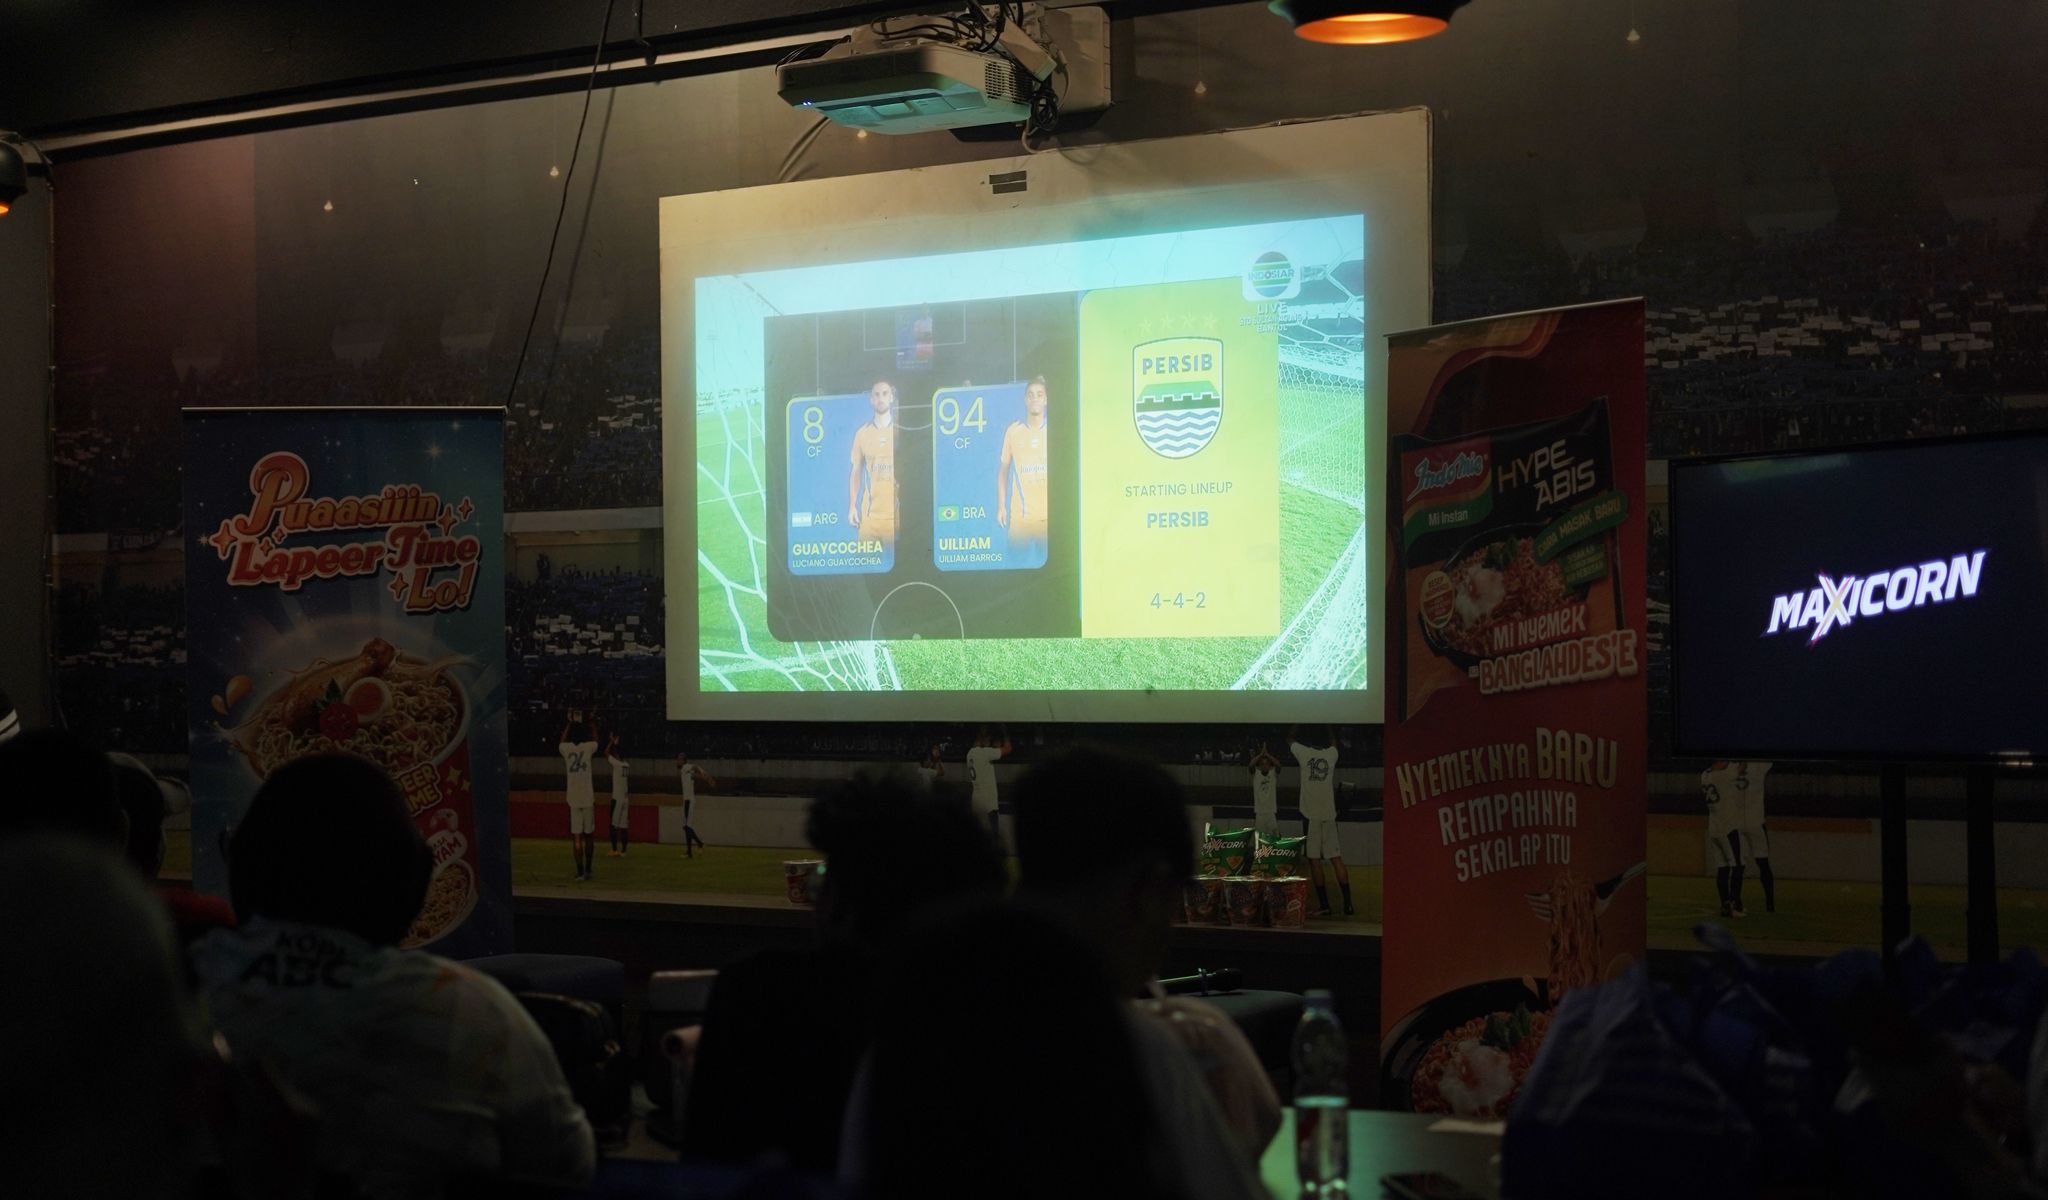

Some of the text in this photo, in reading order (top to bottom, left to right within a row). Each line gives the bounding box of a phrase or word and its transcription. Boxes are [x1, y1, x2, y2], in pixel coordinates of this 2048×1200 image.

[1248, 268, 1295, 280] INDOSIAR
[1258, 302, 1288, 315] LIVE
[1142, 353, 1213, 375] PERSIB
[938, 396, 987, 435] 94
[803, 406, 824, 444] 8
[807, 446, 823, 458] CF
[954, 437, 972, 450] CF
[1498, 438, 1575, 494] HYPE
[1125, 481, 1233, 498] STARTING LINEUP
[1534, 458, 1596, 512] ABIS
[814, 512, 838, 525] ARG
[963, 506, 987, 519] BRA
[1147, 511, 1209, 528] PERSIB
[1429, 509, 1469, 527] Mi Instan
[1559, 508, 1593, 539] MASAK
[792, 541, 883, 556] GUAYCOCHEA
[939, 537, 991, 551] UILLIAM
[227, 525, 480, 590] Lapeer Time
[792, 556, 882, 568] LUCIANO GUAYCOCHEA
[939, 553, 1002, 564] UILLIAM BARROS
[404, 562, 479, 612] Lo!
[1150, 591, 1207, 609] 4-4-2
[1764, 551, 1987, 643] MAXICORN
[1395, 726, 1618, 809] NYEMEKNYA BARU
[1438, 790, 1577, 847] REMPAHNYA
[1454, 833, 1572, 883] SEKALAP ITU
[239, 952, 359, 990] ABC
